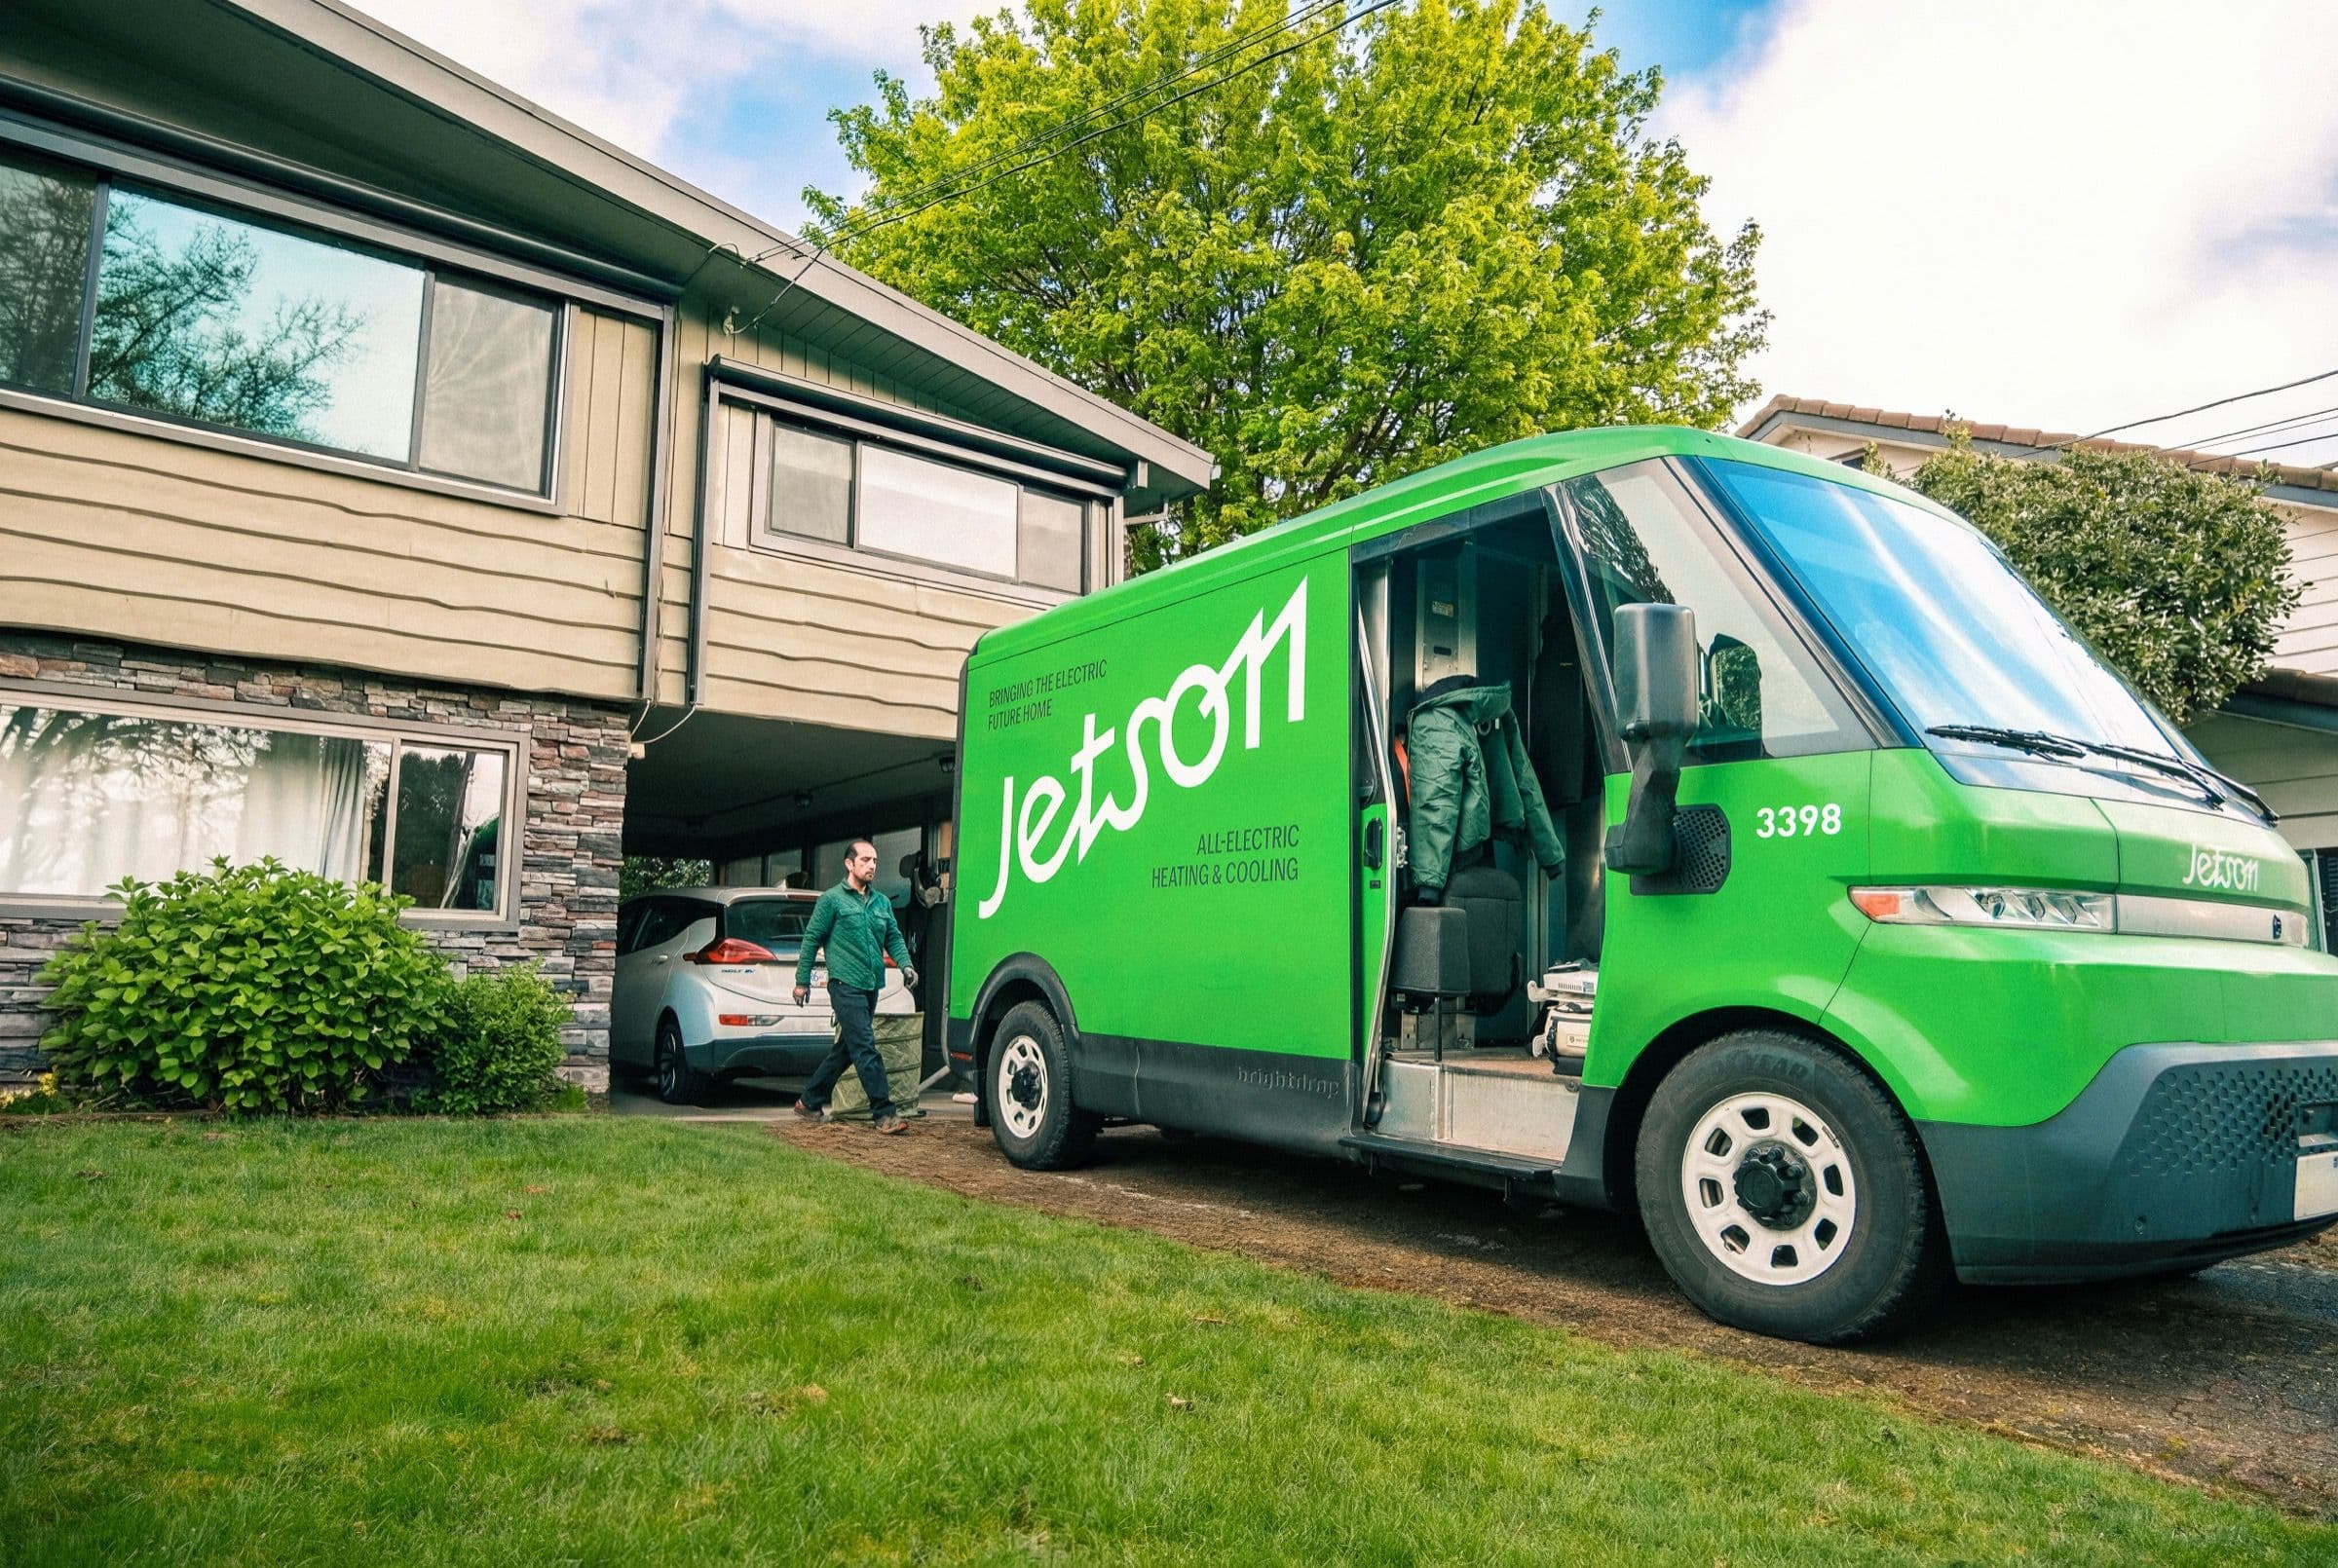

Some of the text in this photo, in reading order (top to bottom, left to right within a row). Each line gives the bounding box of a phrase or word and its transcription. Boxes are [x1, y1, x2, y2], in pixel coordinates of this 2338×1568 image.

[989, 659, 1108, 708] BRINGING THE ELECTRIC
[988, 698, 1052, 730] FUTURE HOME
[978, 575, 1308, 919] Jetson
[1756, 803, 1841, 839] 3398
[1196, 824, 1300, 855] ALL-ELECTRIC
[1151, 857, 1299, 888] HEATING & COOLING
[2182, 842, 2259, 892] Jetson
[1238, 1065, 1340, 1100] brightdrop
